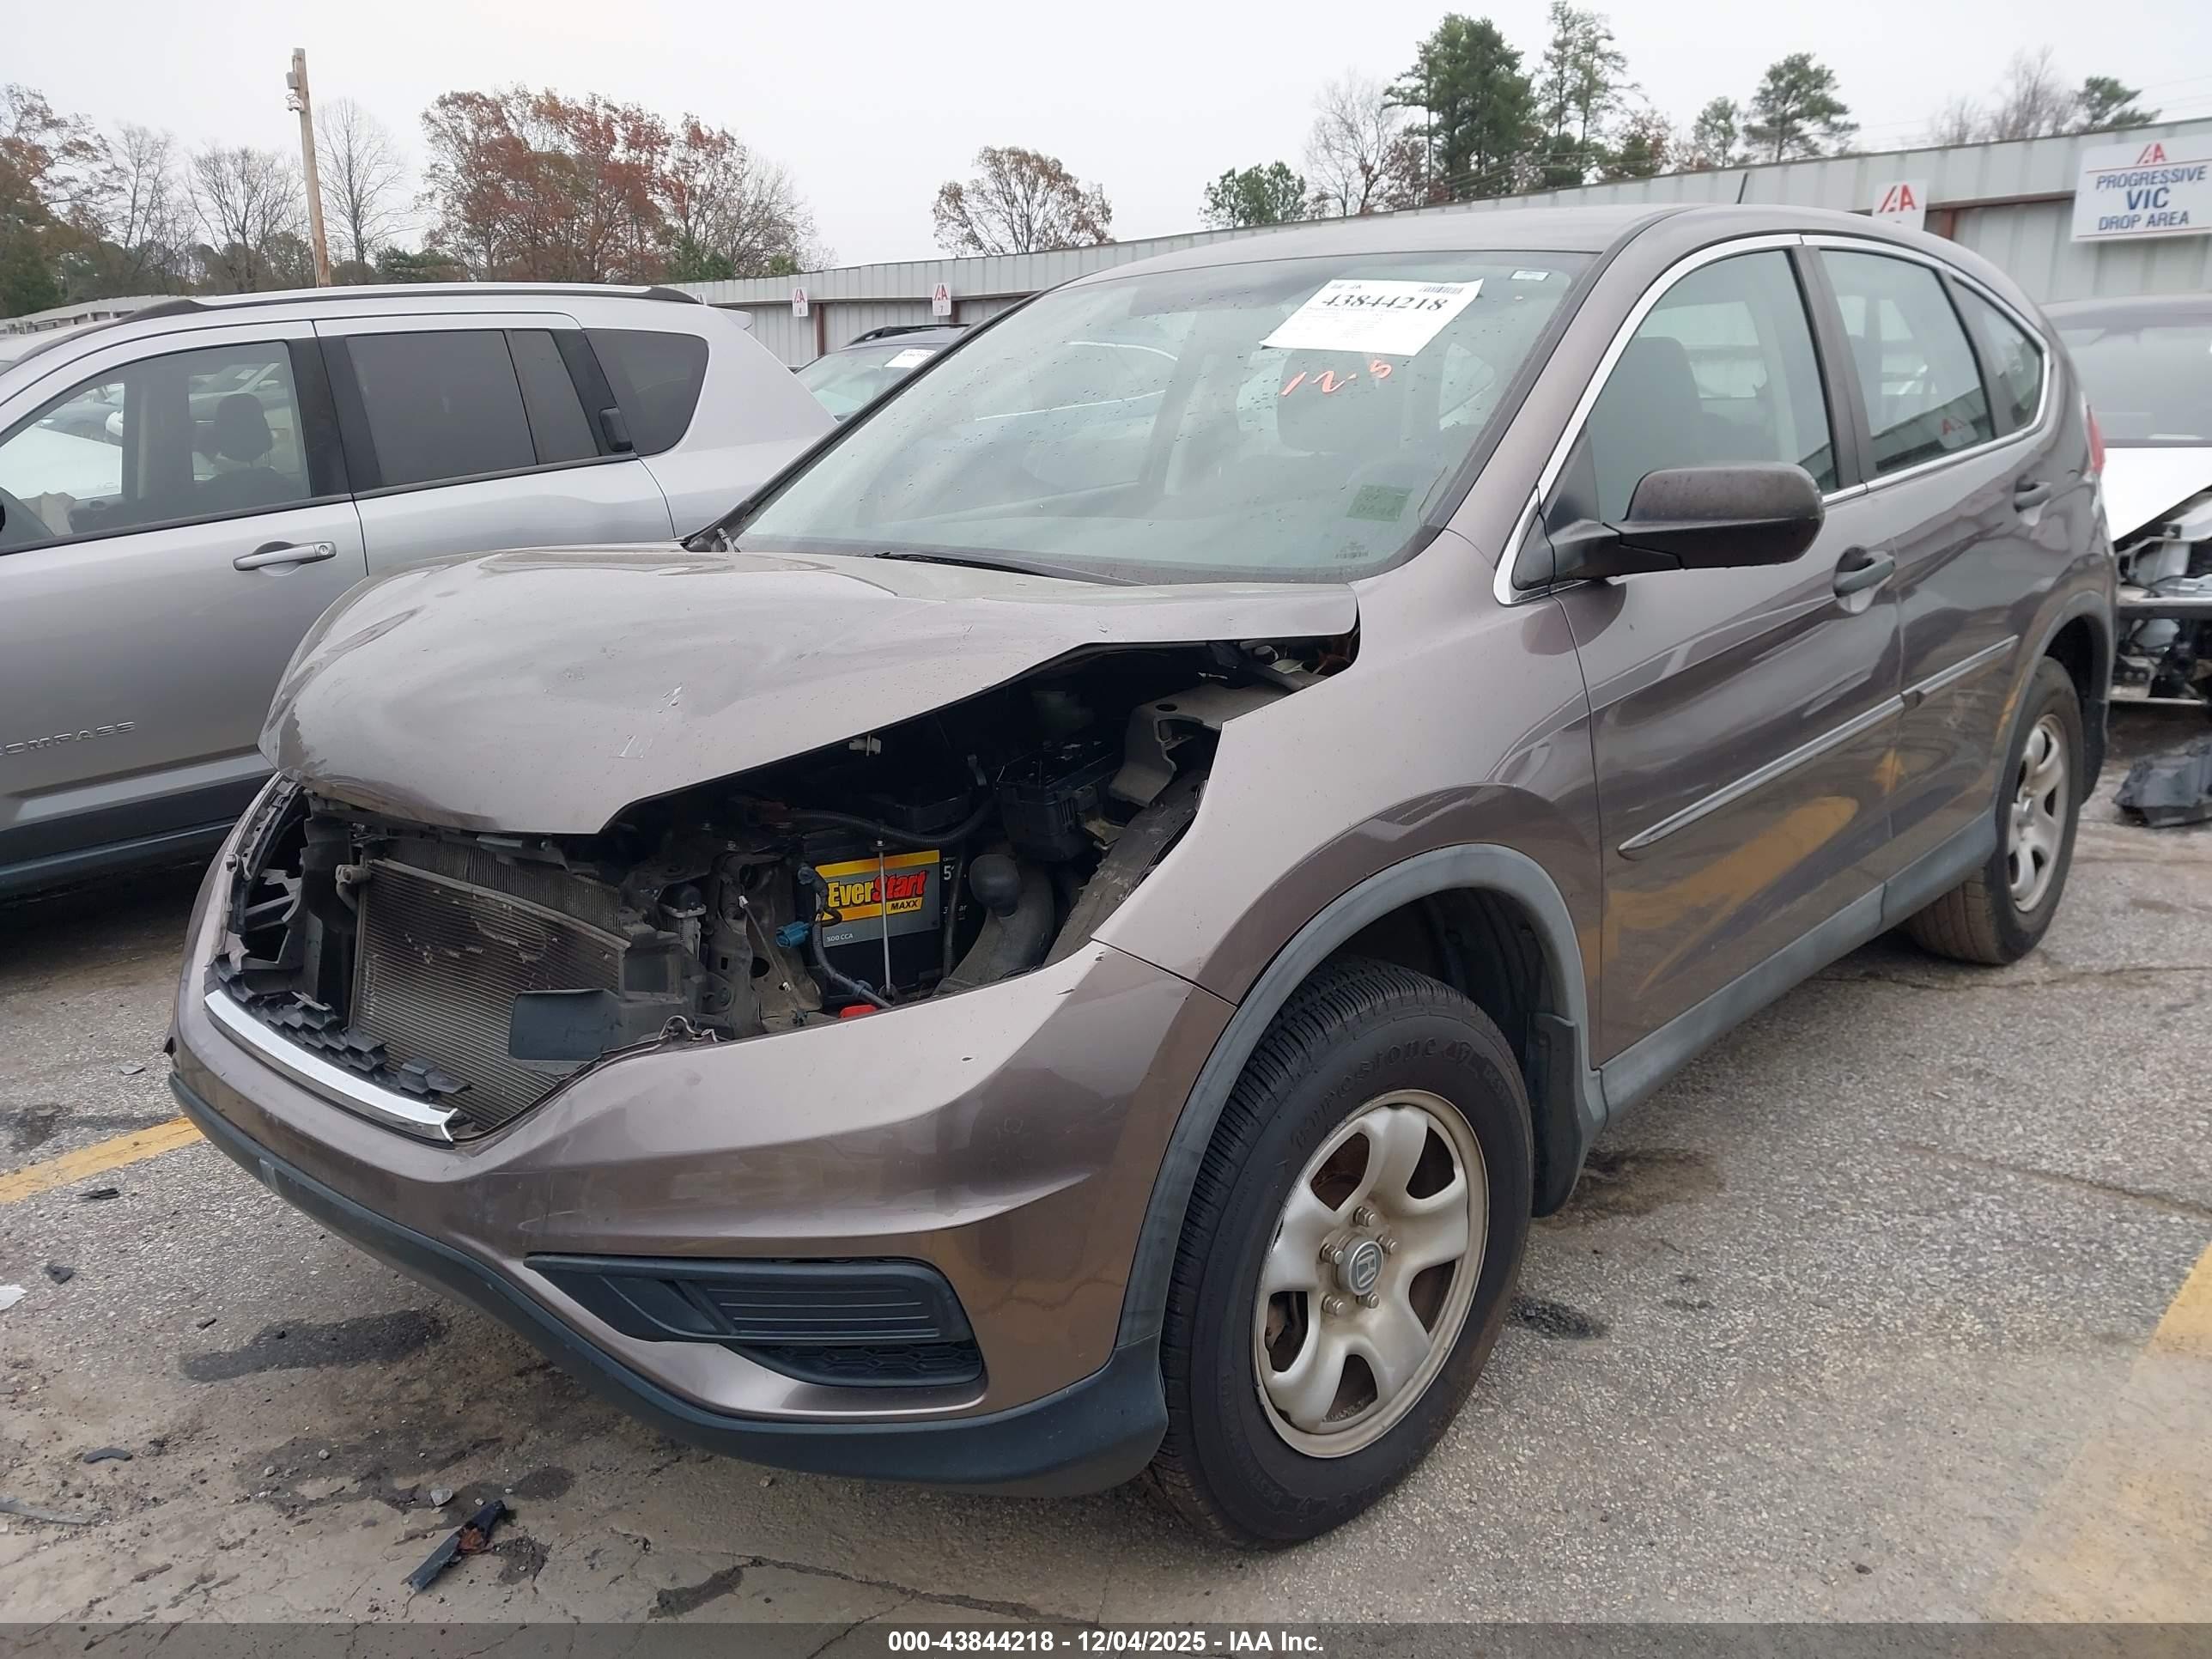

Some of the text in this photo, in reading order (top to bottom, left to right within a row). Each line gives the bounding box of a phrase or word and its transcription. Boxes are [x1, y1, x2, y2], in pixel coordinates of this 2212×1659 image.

[2095, 165, 2209, 190] PROGRESSIVE
[2126, 186, 2170, 210] VIC
[2098, 210, 2190, 231] DROP AREA
[1322, 294, 1449, 312] 43844218
[0, 720, 136, 756] OMPASS
[827, 870, 929, 908] EverStart
[890, 900, 919, 912] MAXX
[826, 934, 840, 943] 500
